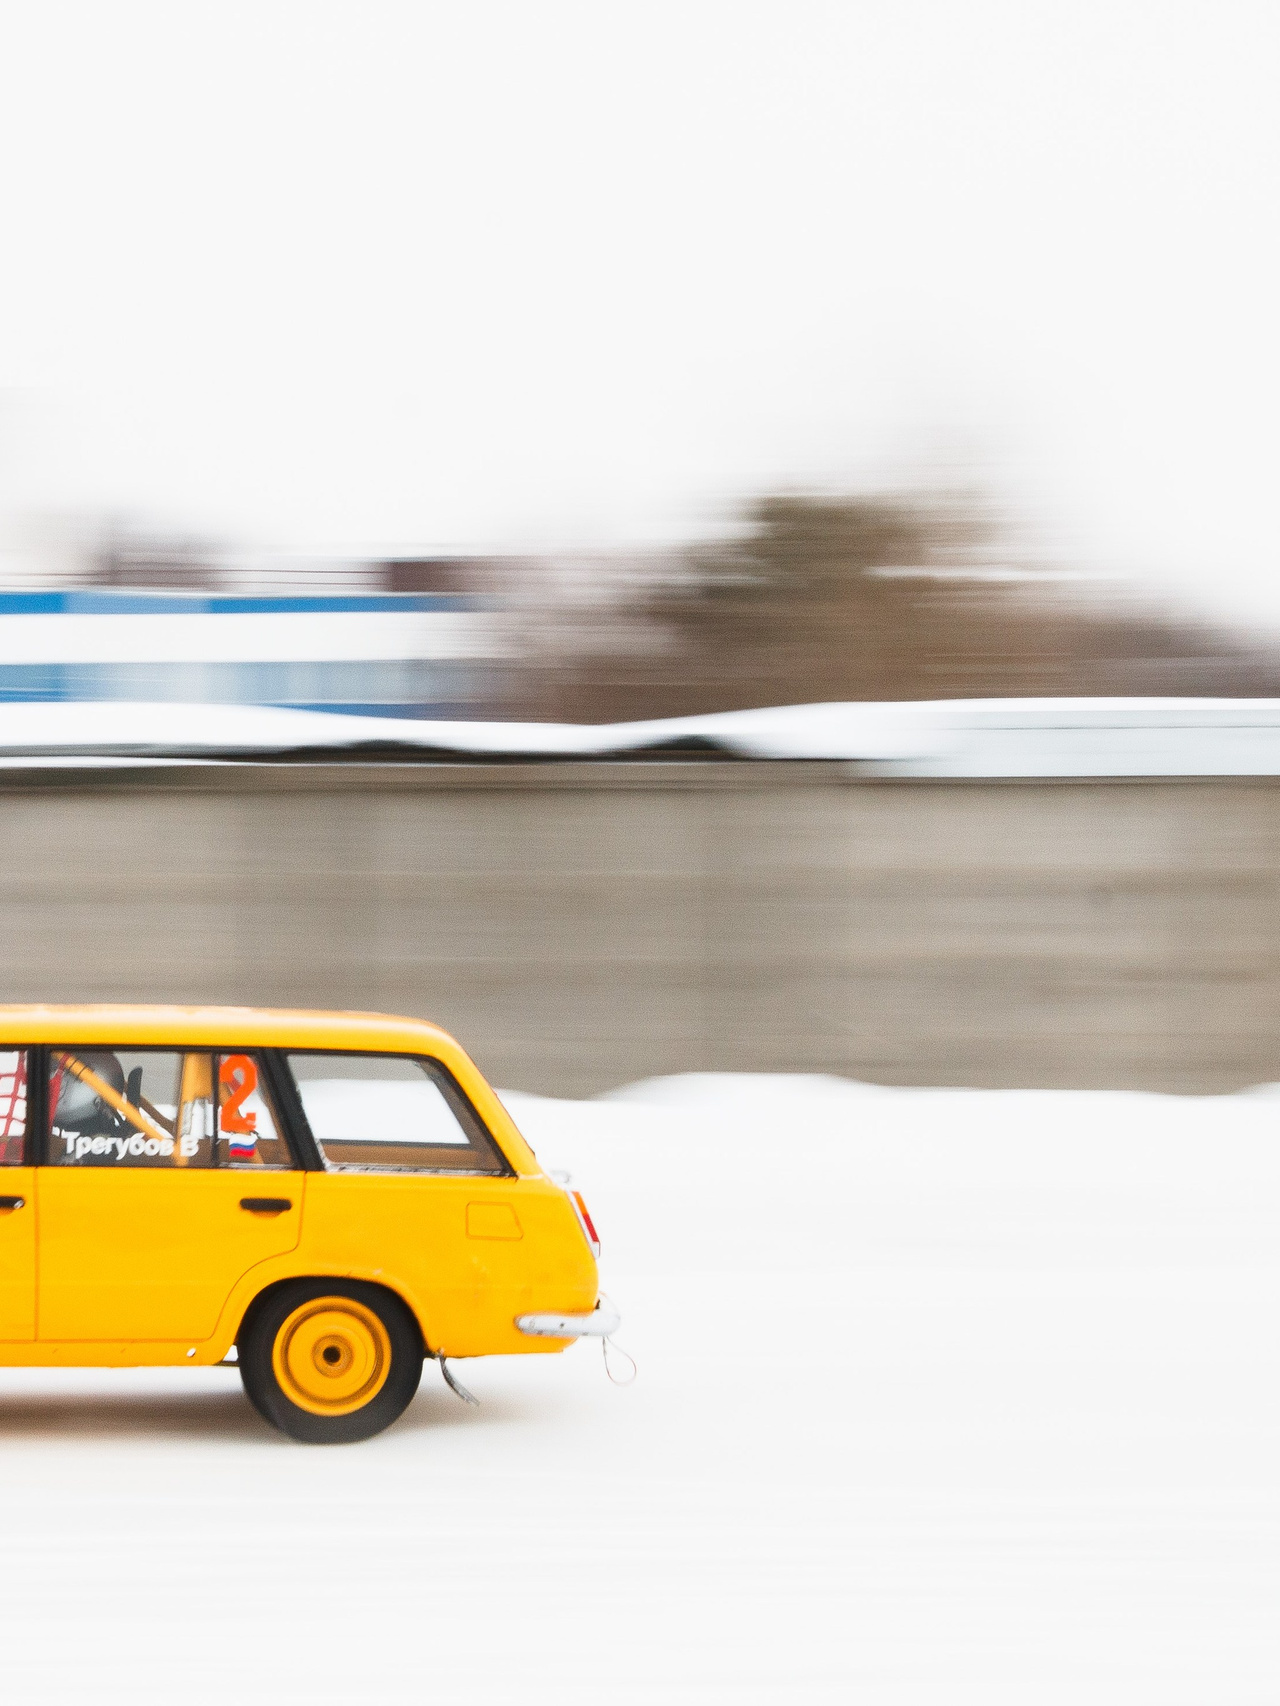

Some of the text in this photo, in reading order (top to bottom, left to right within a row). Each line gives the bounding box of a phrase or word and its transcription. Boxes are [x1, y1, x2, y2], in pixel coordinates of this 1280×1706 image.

[219, 1054, 258, 1132] 2
[61, 1131, 199, 1160] Трегубов В
